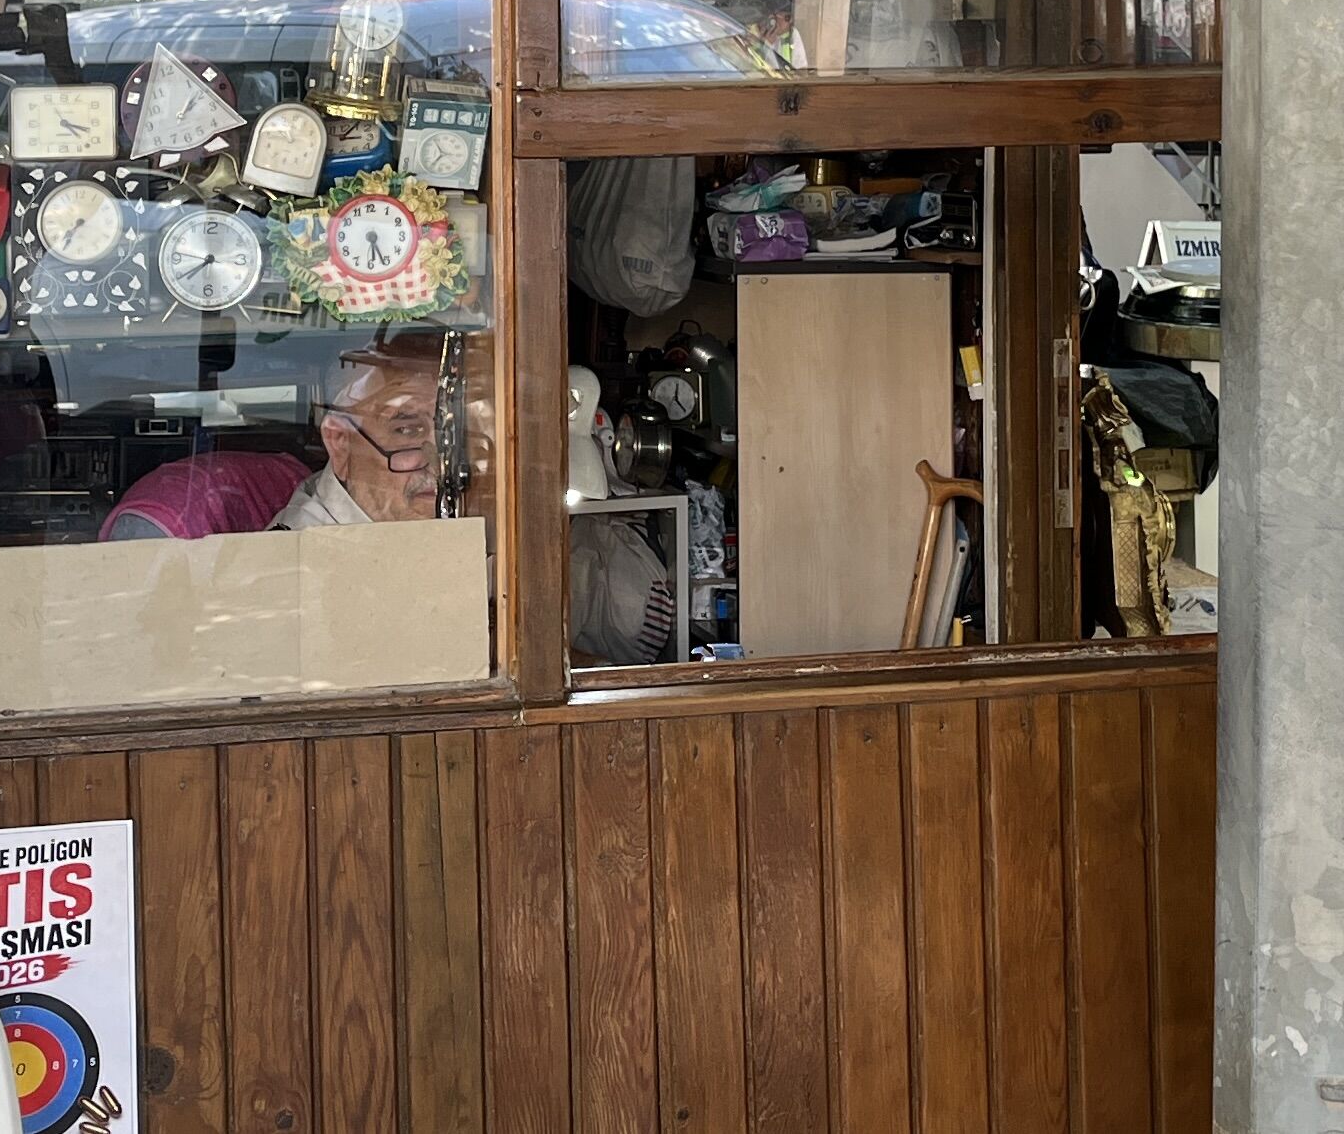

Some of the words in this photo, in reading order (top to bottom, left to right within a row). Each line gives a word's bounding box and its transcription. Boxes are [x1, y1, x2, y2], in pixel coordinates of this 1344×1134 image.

[203, 222, 218, 234] 12
[1175, 234, 1221, 257] İZMİR
[172, 252, 181, 265] 9
[235, 254, 246, 265] 3
[203, 284, 213, 297] 6
[16, 838, 93, 867] POLİGON
